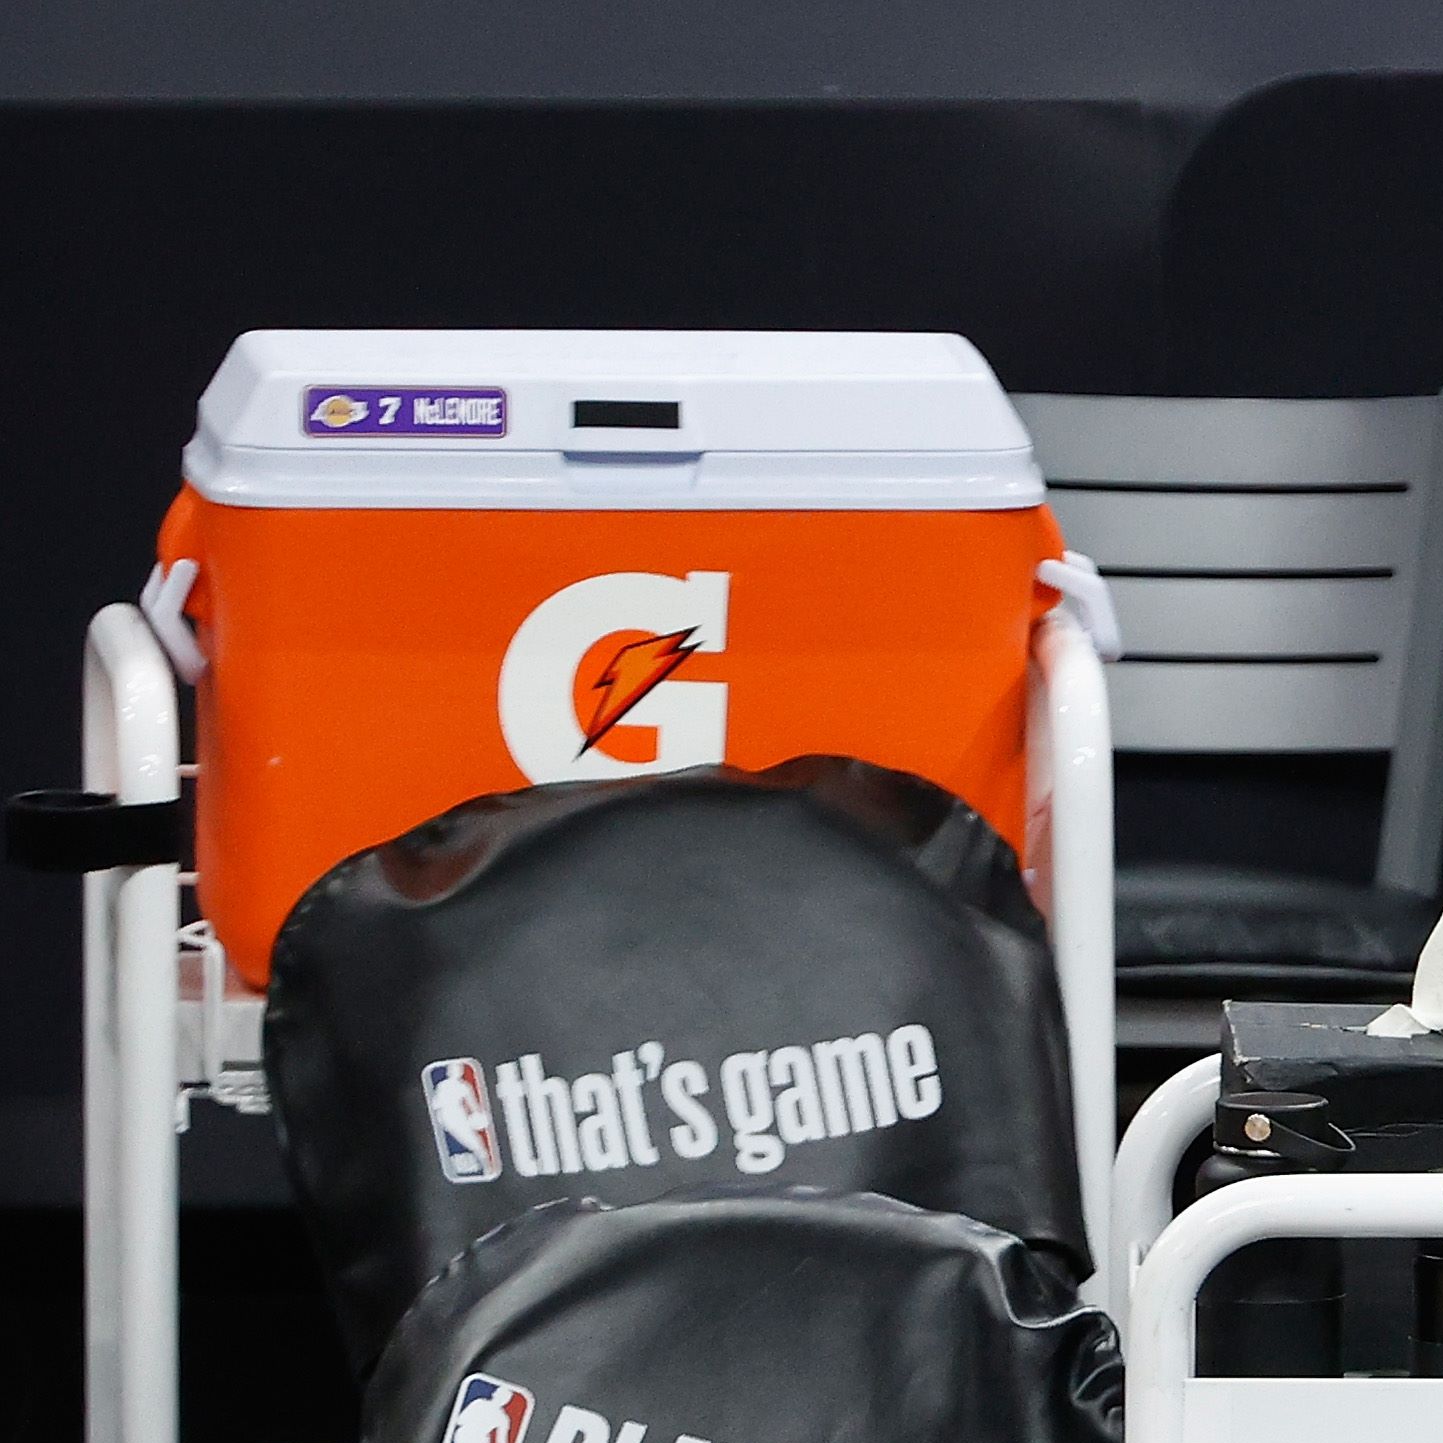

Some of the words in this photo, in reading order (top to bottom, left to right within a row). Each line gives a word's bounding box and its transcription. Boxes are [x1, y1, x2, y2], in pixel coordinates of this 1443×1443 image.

[378, 397, 402, 425] 7
[498, 569, 731, 785] G
[495, 1040, 719, 1177] that's
[720, 1023, 944, 1175] game
